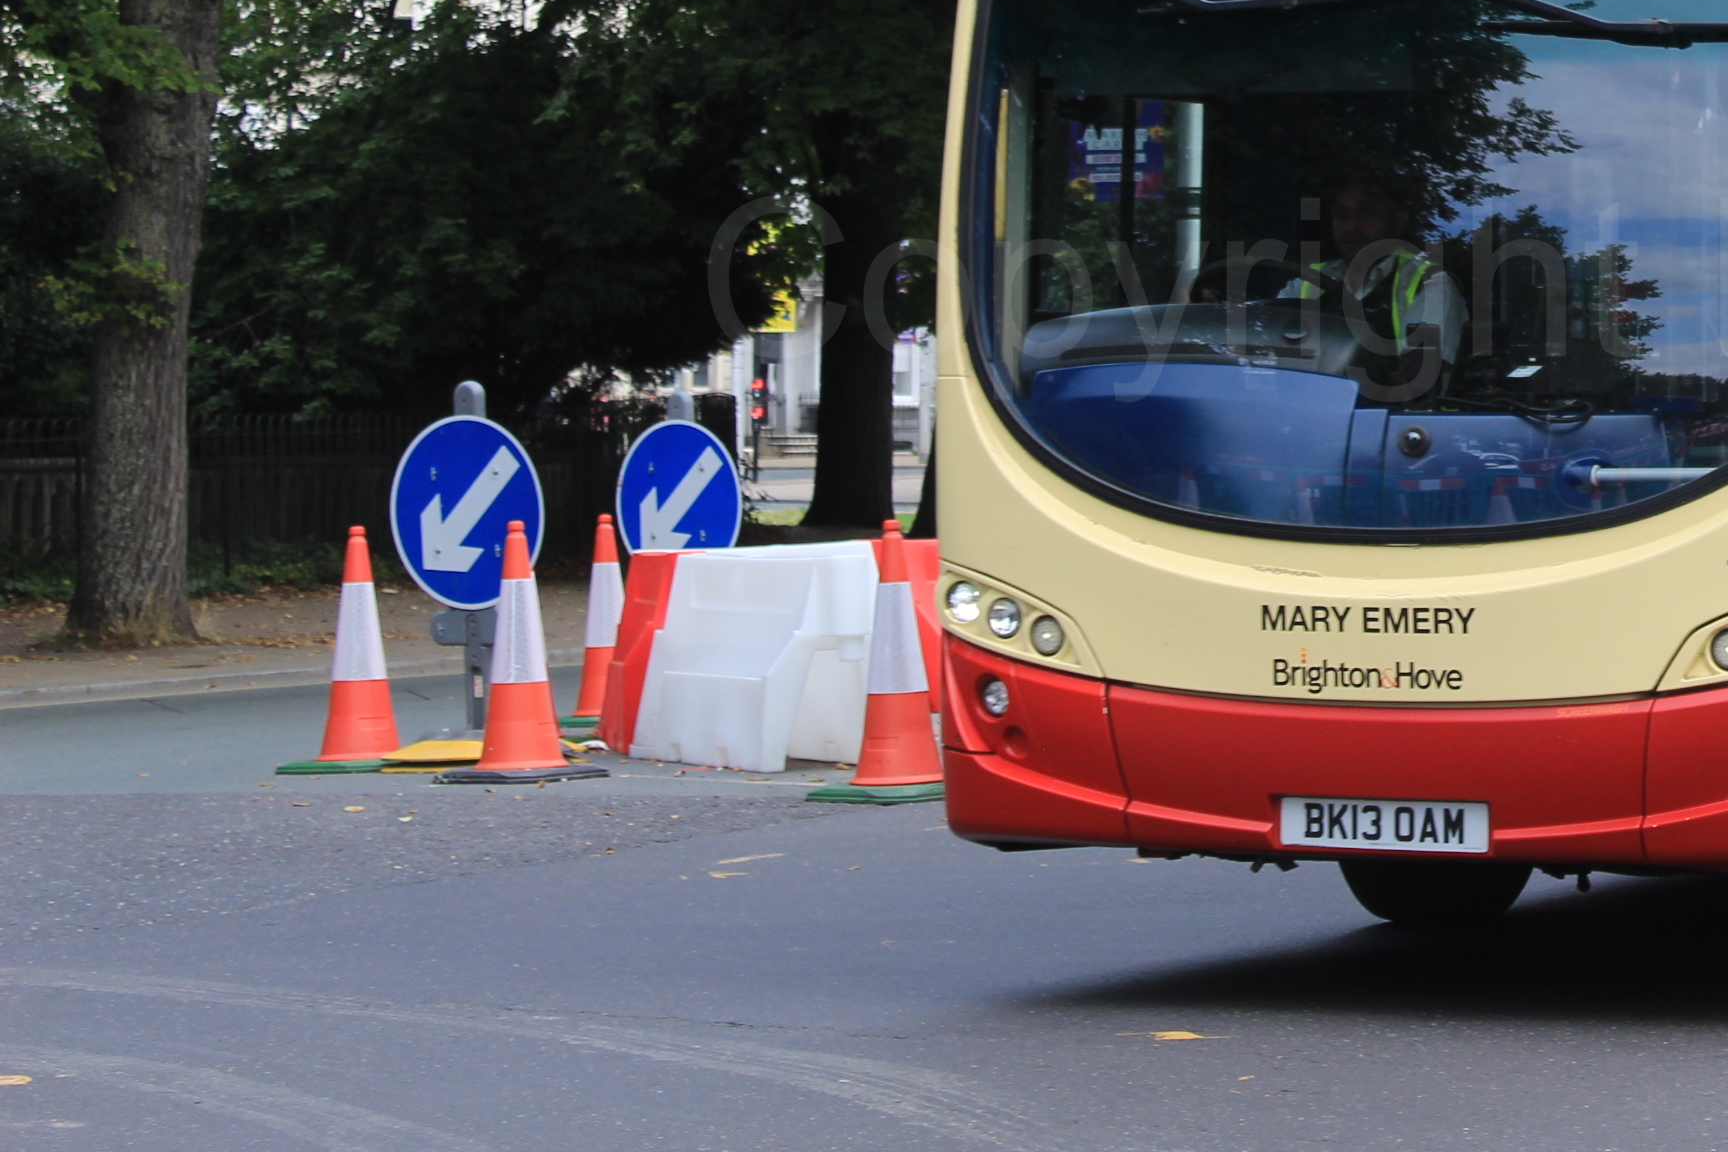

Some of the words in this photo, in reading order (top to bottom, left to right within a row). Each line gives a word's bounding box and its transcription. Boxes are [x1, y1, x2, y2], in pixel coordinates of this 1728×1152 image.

[1261, 604, 1350, 632] MARY
[1362, 606, 1476, 635] EMERY
[1304, 802, 1381, 840] BK13
[1395, 806, 1464, 845] OAM
